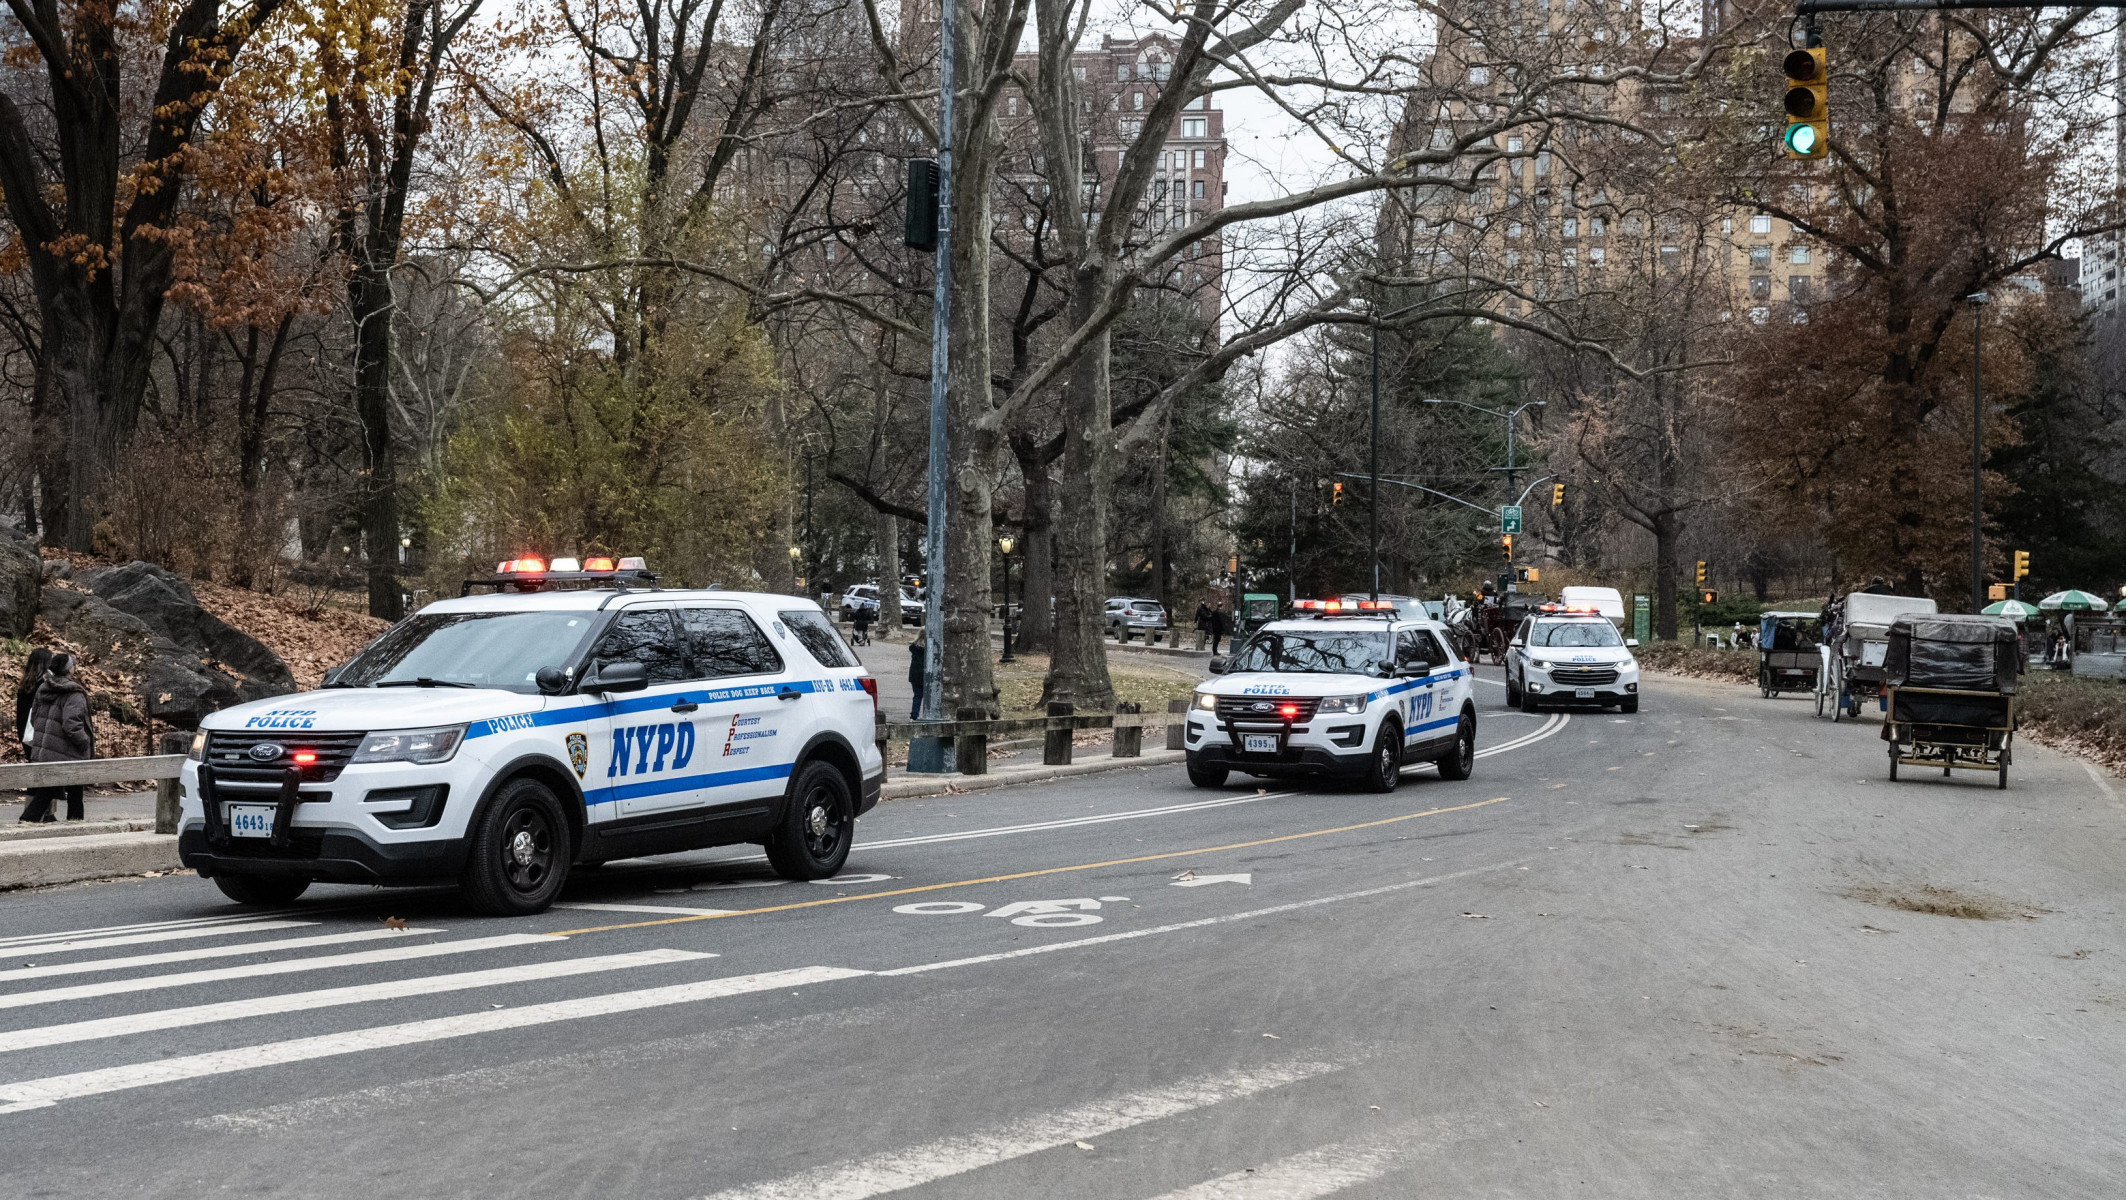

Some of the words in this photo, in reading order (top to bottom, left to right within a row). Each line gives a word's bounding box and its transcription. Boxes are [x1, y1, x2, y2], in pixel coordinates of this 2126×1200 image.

[708, 691, 730, 700] POLICE
[744, 688, 758, 696] KEEP
[1409, 692, 1433, 723] NYPD
[245, 717, 317, 728] POLICE
[489, 713, 535, 734] POLICE
[607, 721, 695, 778] NYPD
[1248, 740, 1268, 748] 4395
[255, 746, 274, 757] Ford
[235, 815, 264, 830] 4643
